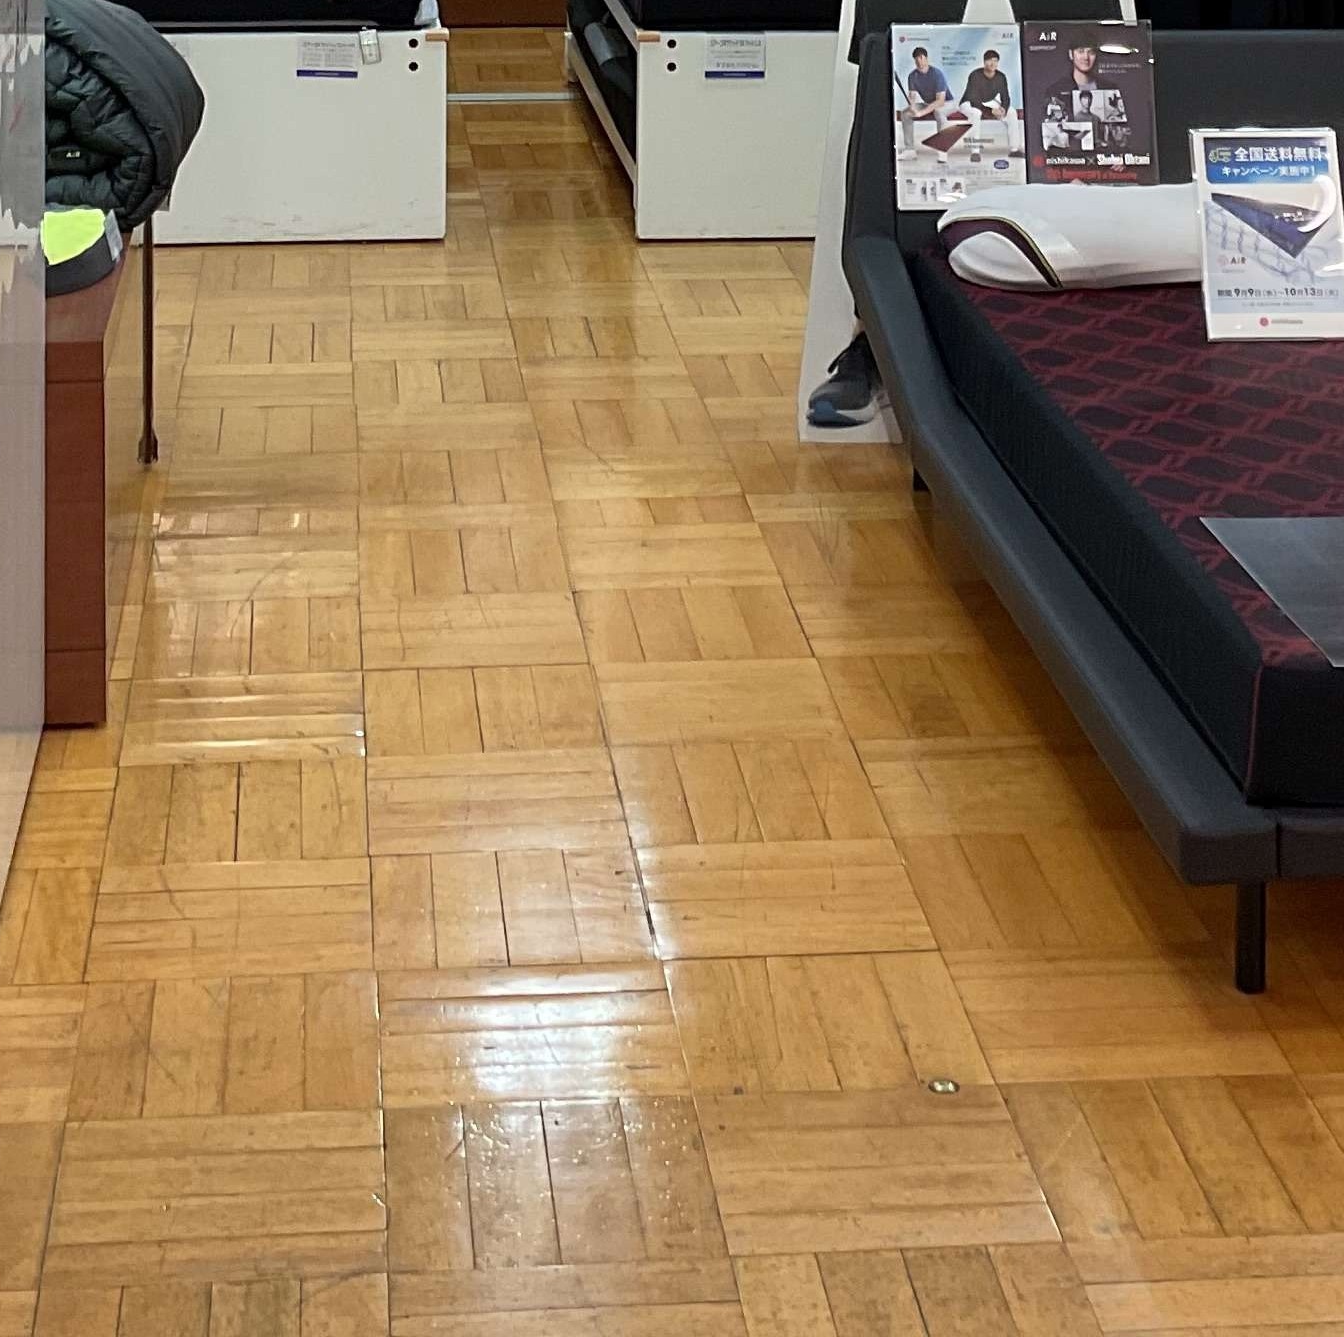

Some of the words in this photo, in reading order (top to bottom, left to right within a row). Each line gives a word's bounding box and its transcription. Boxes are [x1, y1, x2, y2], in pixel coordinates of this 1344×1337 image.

[1234, 147, 1323, 162] 全国送料無料
